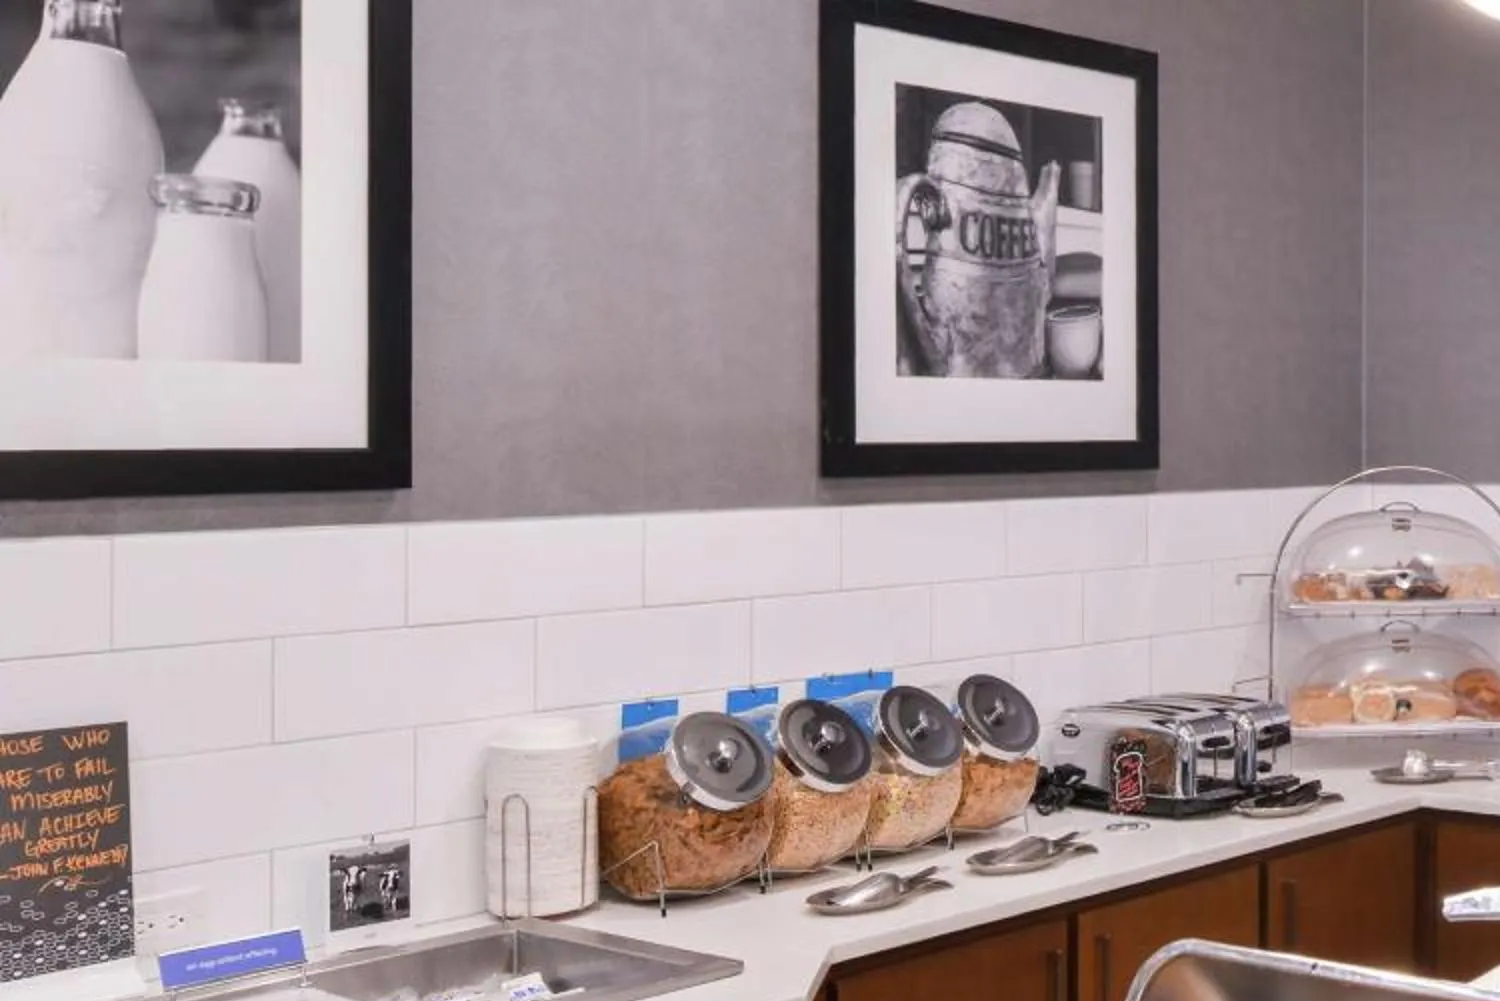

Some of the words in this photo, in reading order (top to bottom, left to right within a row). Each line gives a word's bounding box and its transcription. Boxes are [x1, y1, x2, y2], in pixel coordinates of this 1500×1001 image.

[62, 728, 111, 751] WHO
[37, 762, 66, 784] TO
[75, 756, 117, 780] FAIL
[11, 780, 114, 812] MISERABLY
[0, 816, 27, 844] AN
[40, 803, 126, 836] ACHIEVE
[25, 829, 99, 858] GREATLY
